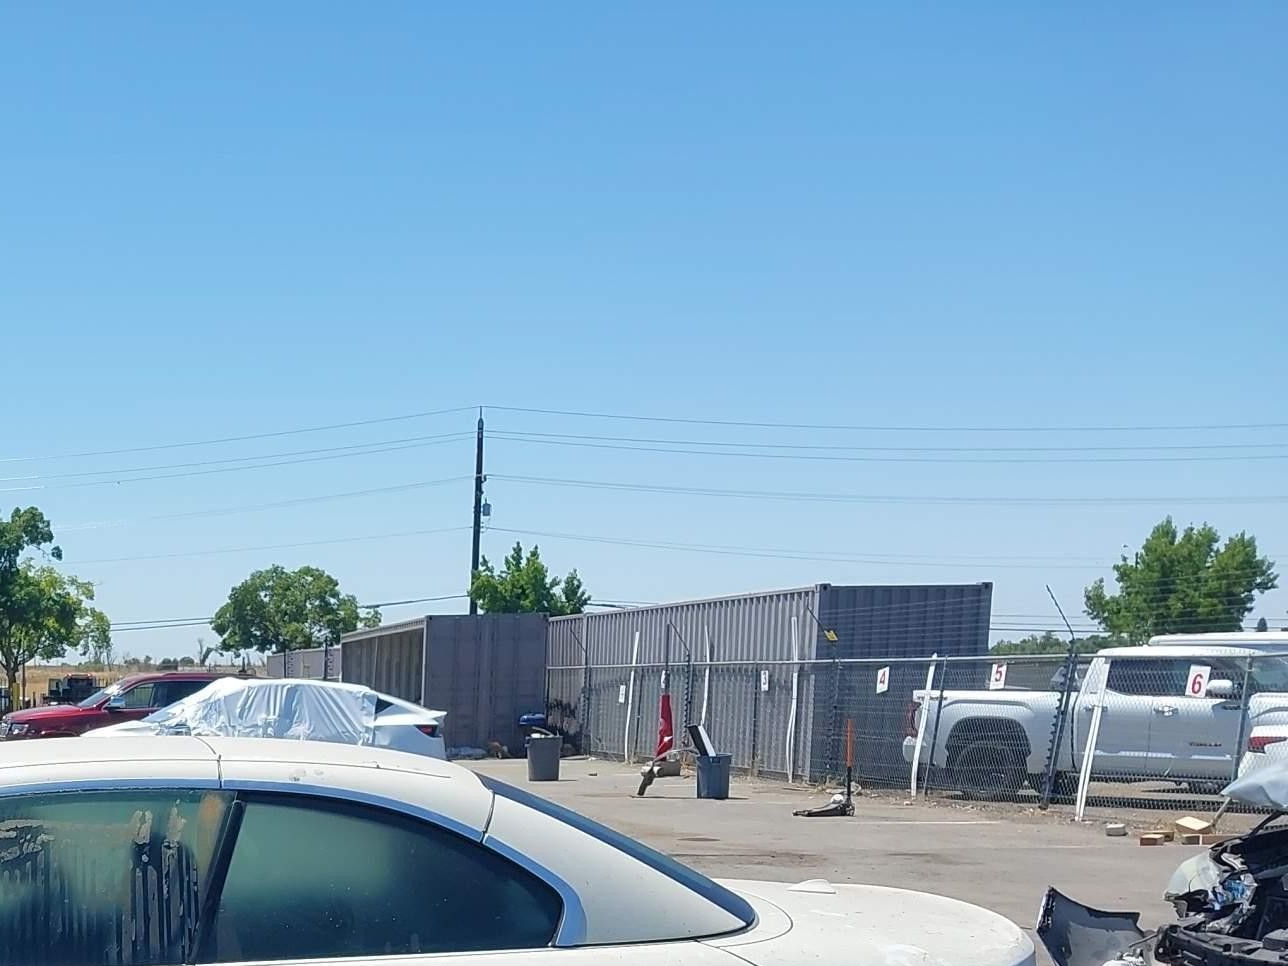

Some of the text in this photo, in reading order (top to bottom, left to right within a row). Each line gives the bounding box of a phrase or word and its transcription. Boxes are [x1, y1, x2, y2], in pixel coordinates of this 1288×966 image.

[879, 670, 886, 685] 4
[994, 663, 1005, 682] 5
[1191, 673, 1203, 694] 6
